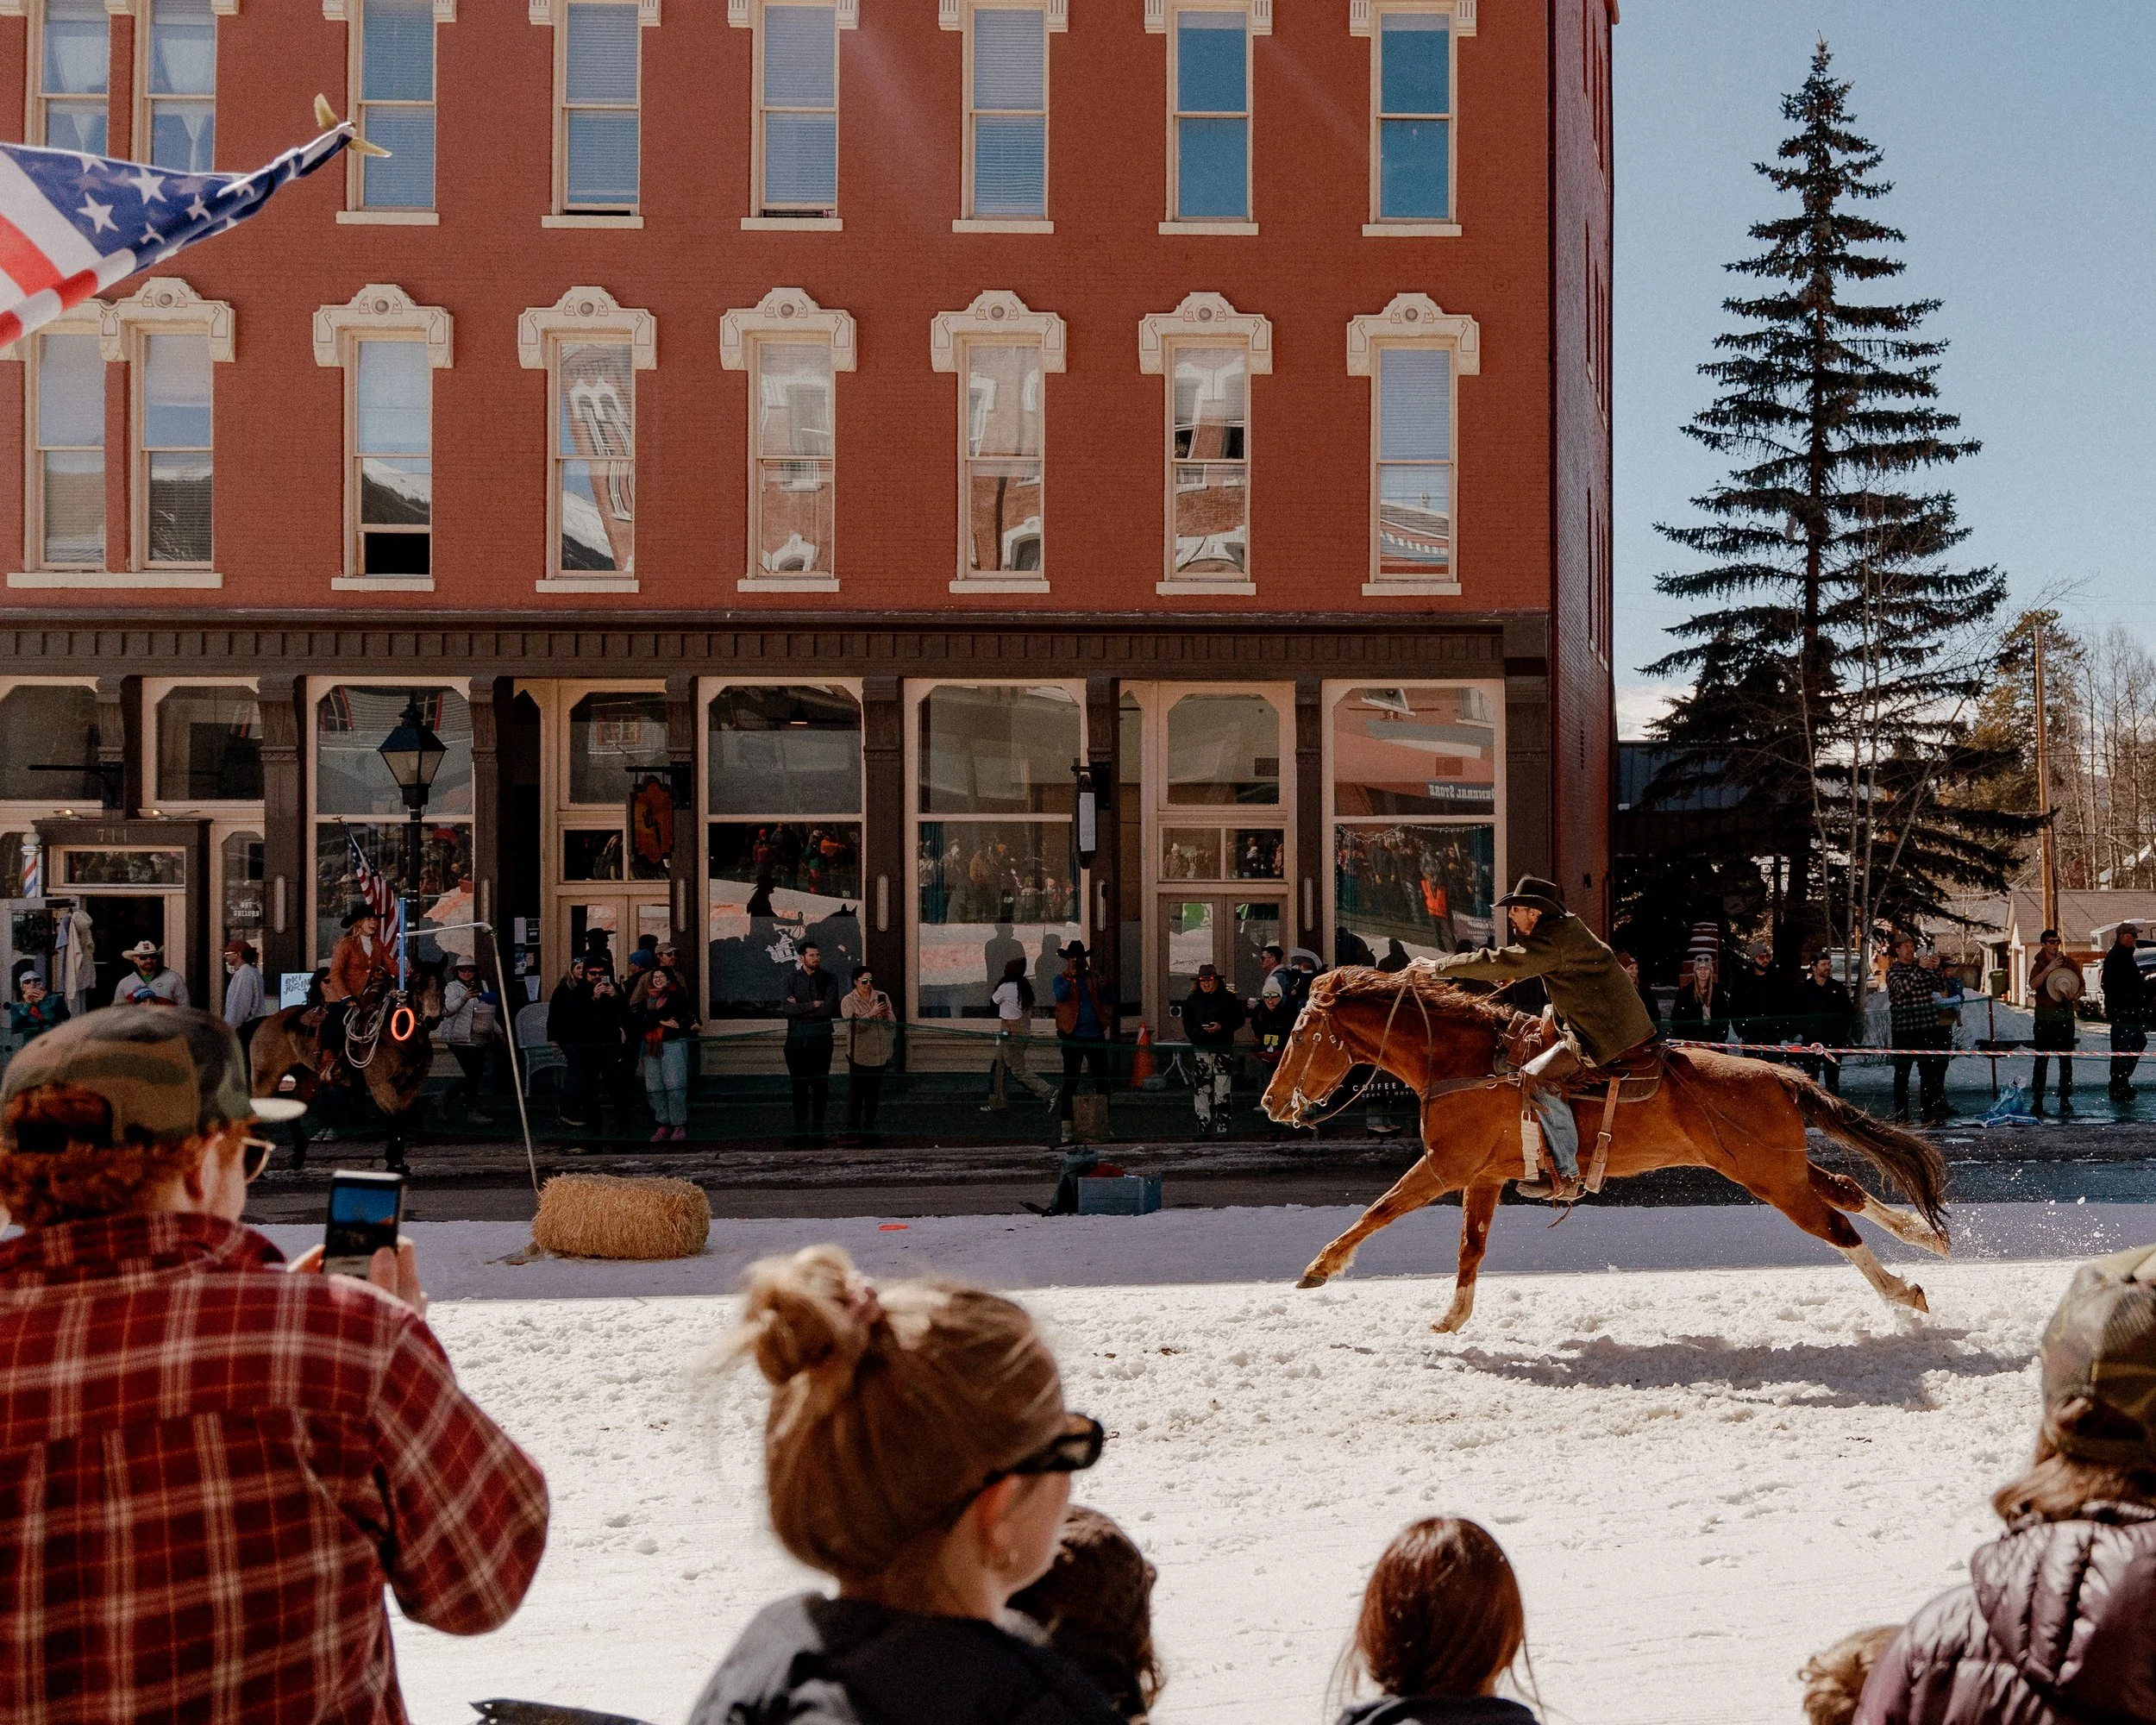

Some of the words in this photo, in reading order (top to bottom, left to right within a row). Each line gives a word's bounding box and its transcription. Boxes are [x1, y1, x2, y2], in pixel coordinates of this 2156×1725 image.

[97, 828, 128, 843] 711
[285, 974, 302, 985] SKI
[1352, 1082, 1396, 1092] COFFEE
